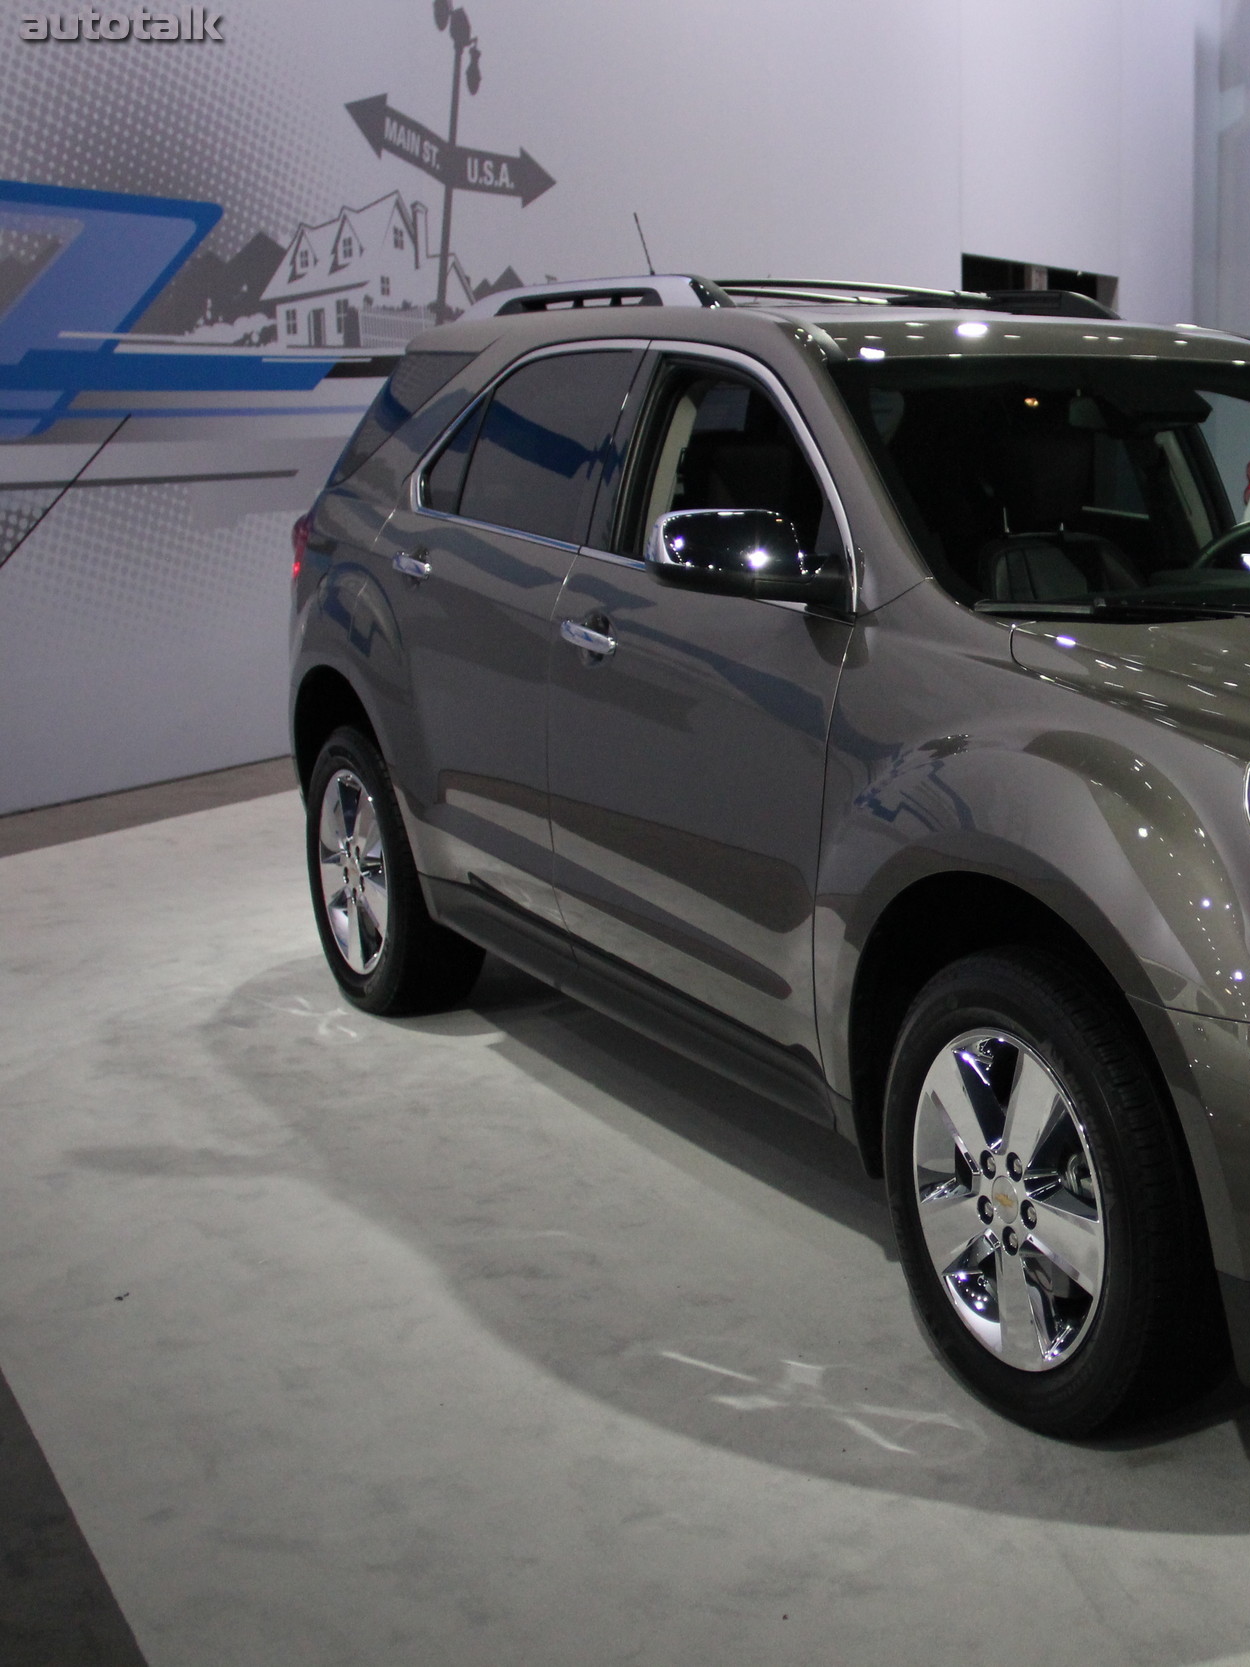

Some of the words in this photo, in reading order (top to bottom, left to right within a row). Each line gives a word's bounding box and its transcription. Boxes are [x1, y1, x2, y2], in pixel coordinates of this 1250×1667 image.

[384, 116, 421, 157] MAIN
[422, 140, 440, 171] ST.
[466, 157, 515, 189] U.S.A.
